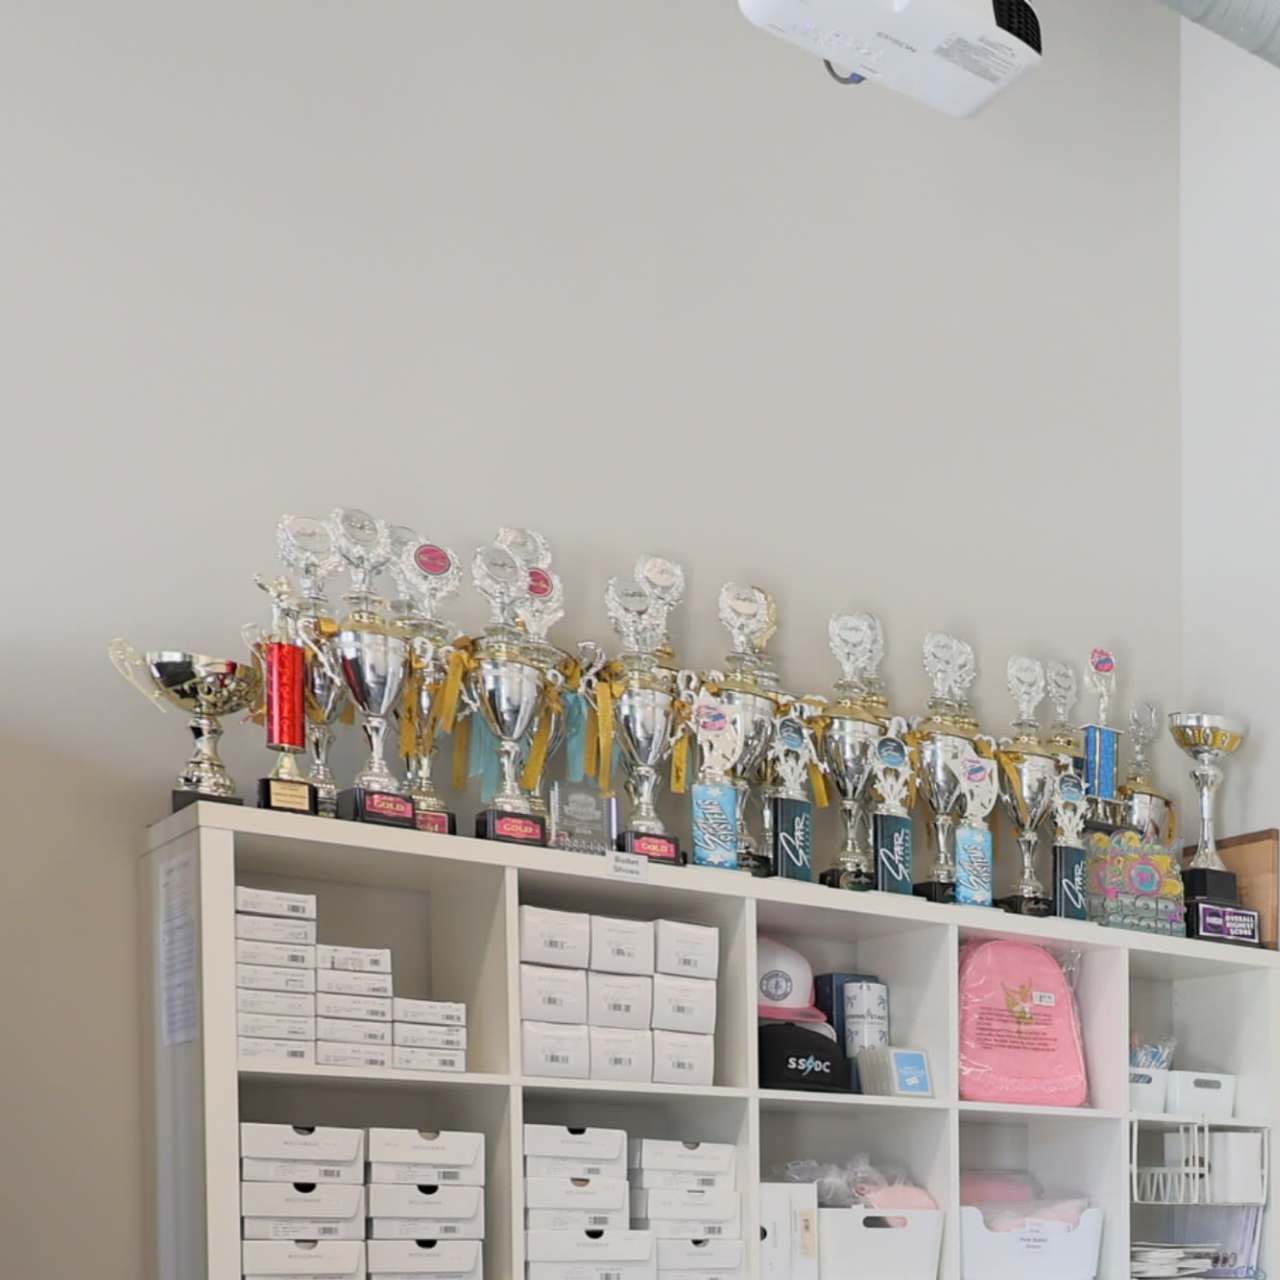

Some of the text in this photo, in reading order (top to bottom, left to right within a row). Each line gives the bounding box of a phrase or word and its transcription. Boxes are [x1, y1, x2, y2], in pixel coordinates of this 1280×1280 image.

[373, 800, 405, 813] GOLD
[502, 822, 533, 834] GOLD
[640, 841, 669, 854] GOLD
